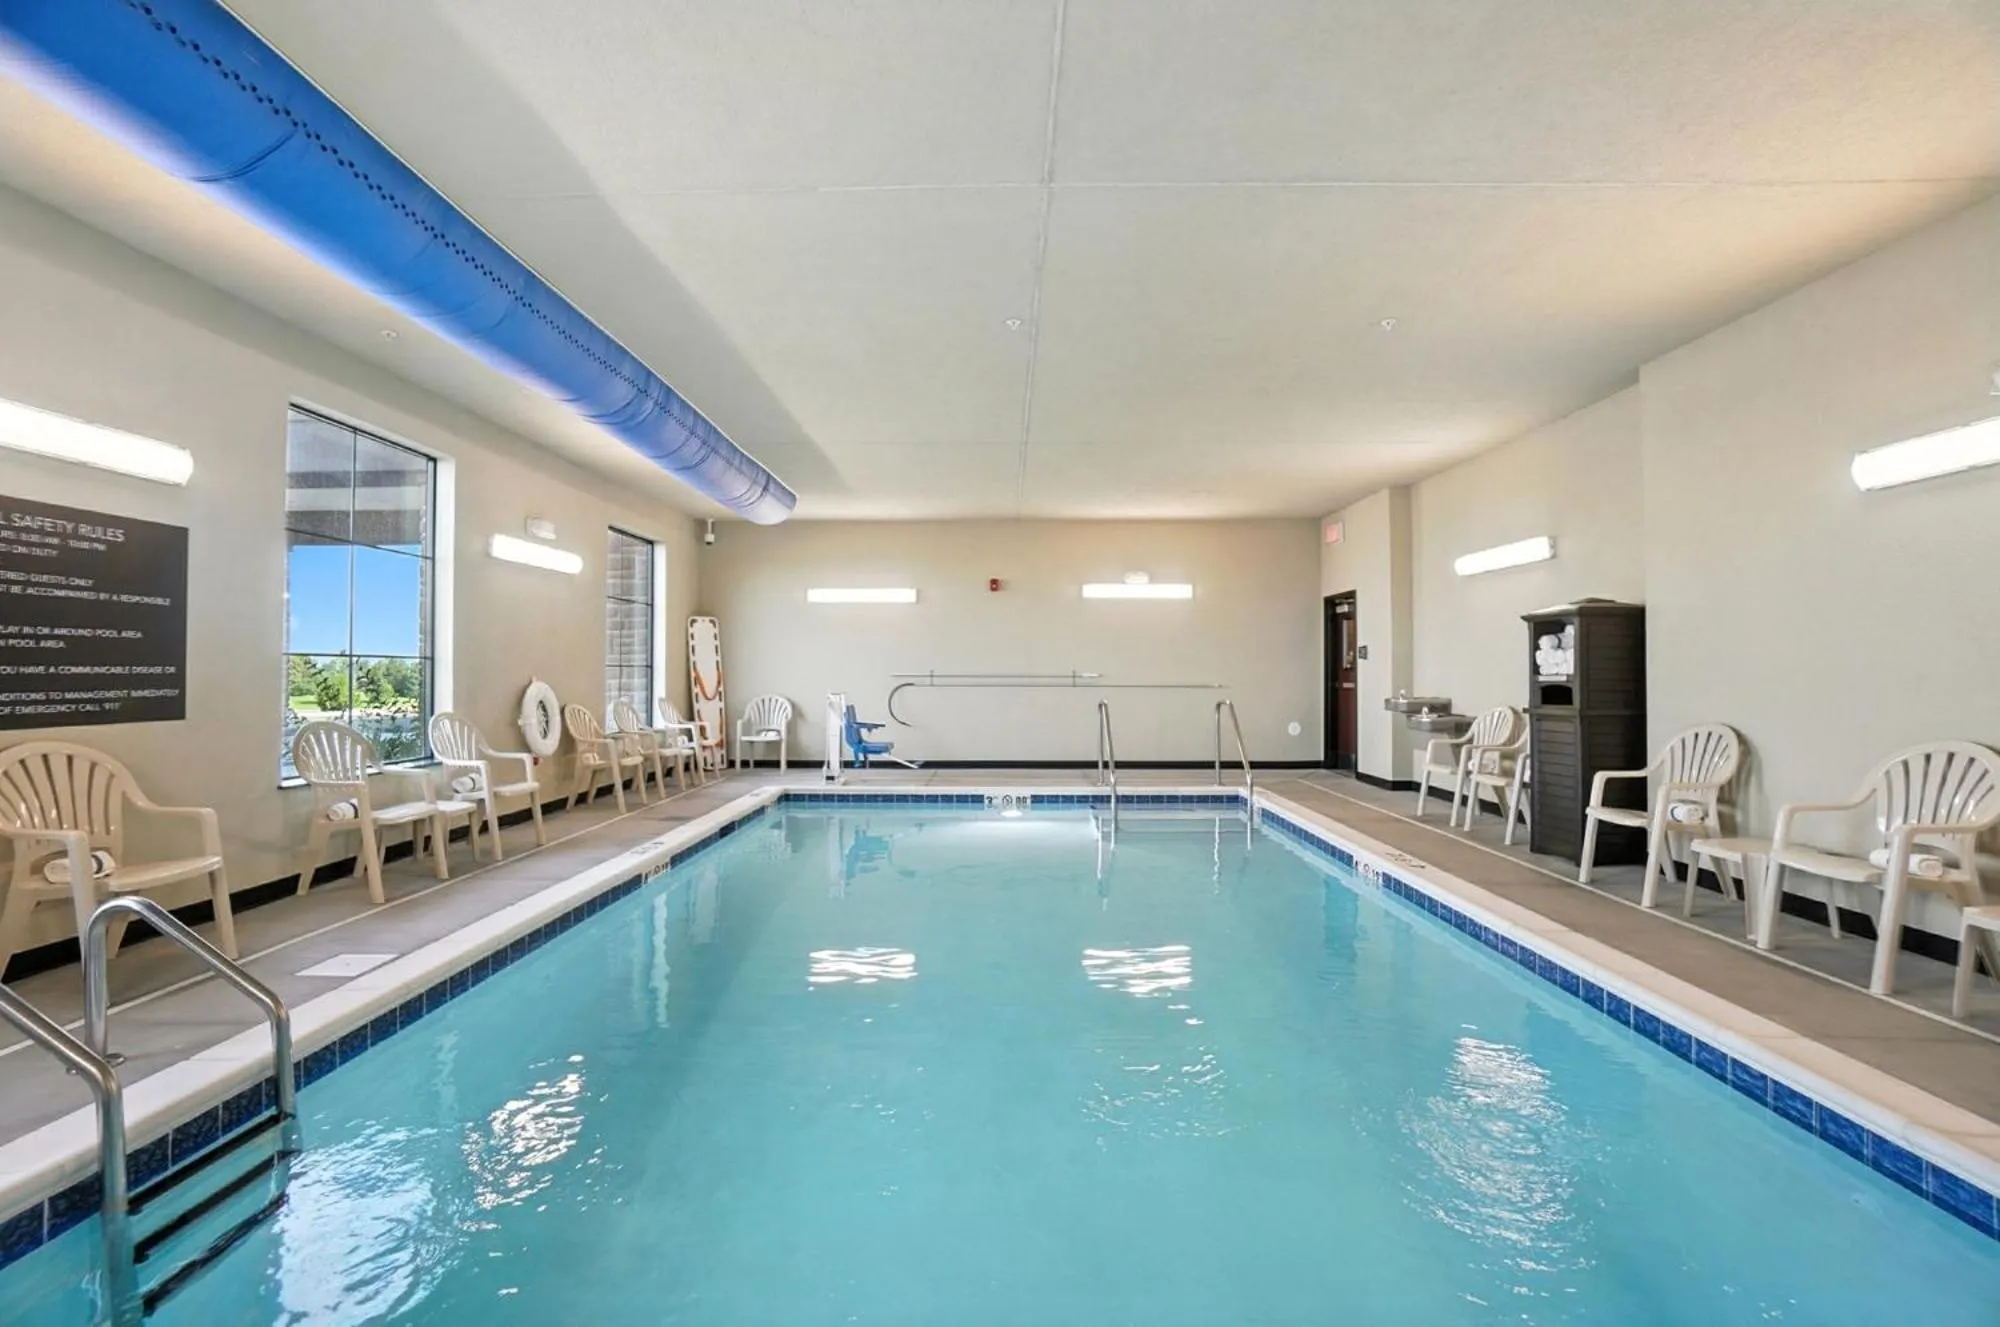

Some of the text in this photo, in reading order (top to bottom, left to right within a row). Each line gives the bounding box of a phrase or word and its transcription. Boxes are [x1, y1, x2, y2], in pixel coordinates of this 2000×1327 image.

[11, 512, 76, 534] SAFETY
[78, 523, 126, 542] RULES
[8, 639, 39, 649] POOL
[19, 665, 46, 675] HAVE
[131, 665, 163, 675] DISEASE
[49, 691, 62, 700] TO
[64, 689, 129, 700] MANAGEMENT
[15, 703, 78, 715] EMERGENCY
[79, 702, 102, 713] CALL
